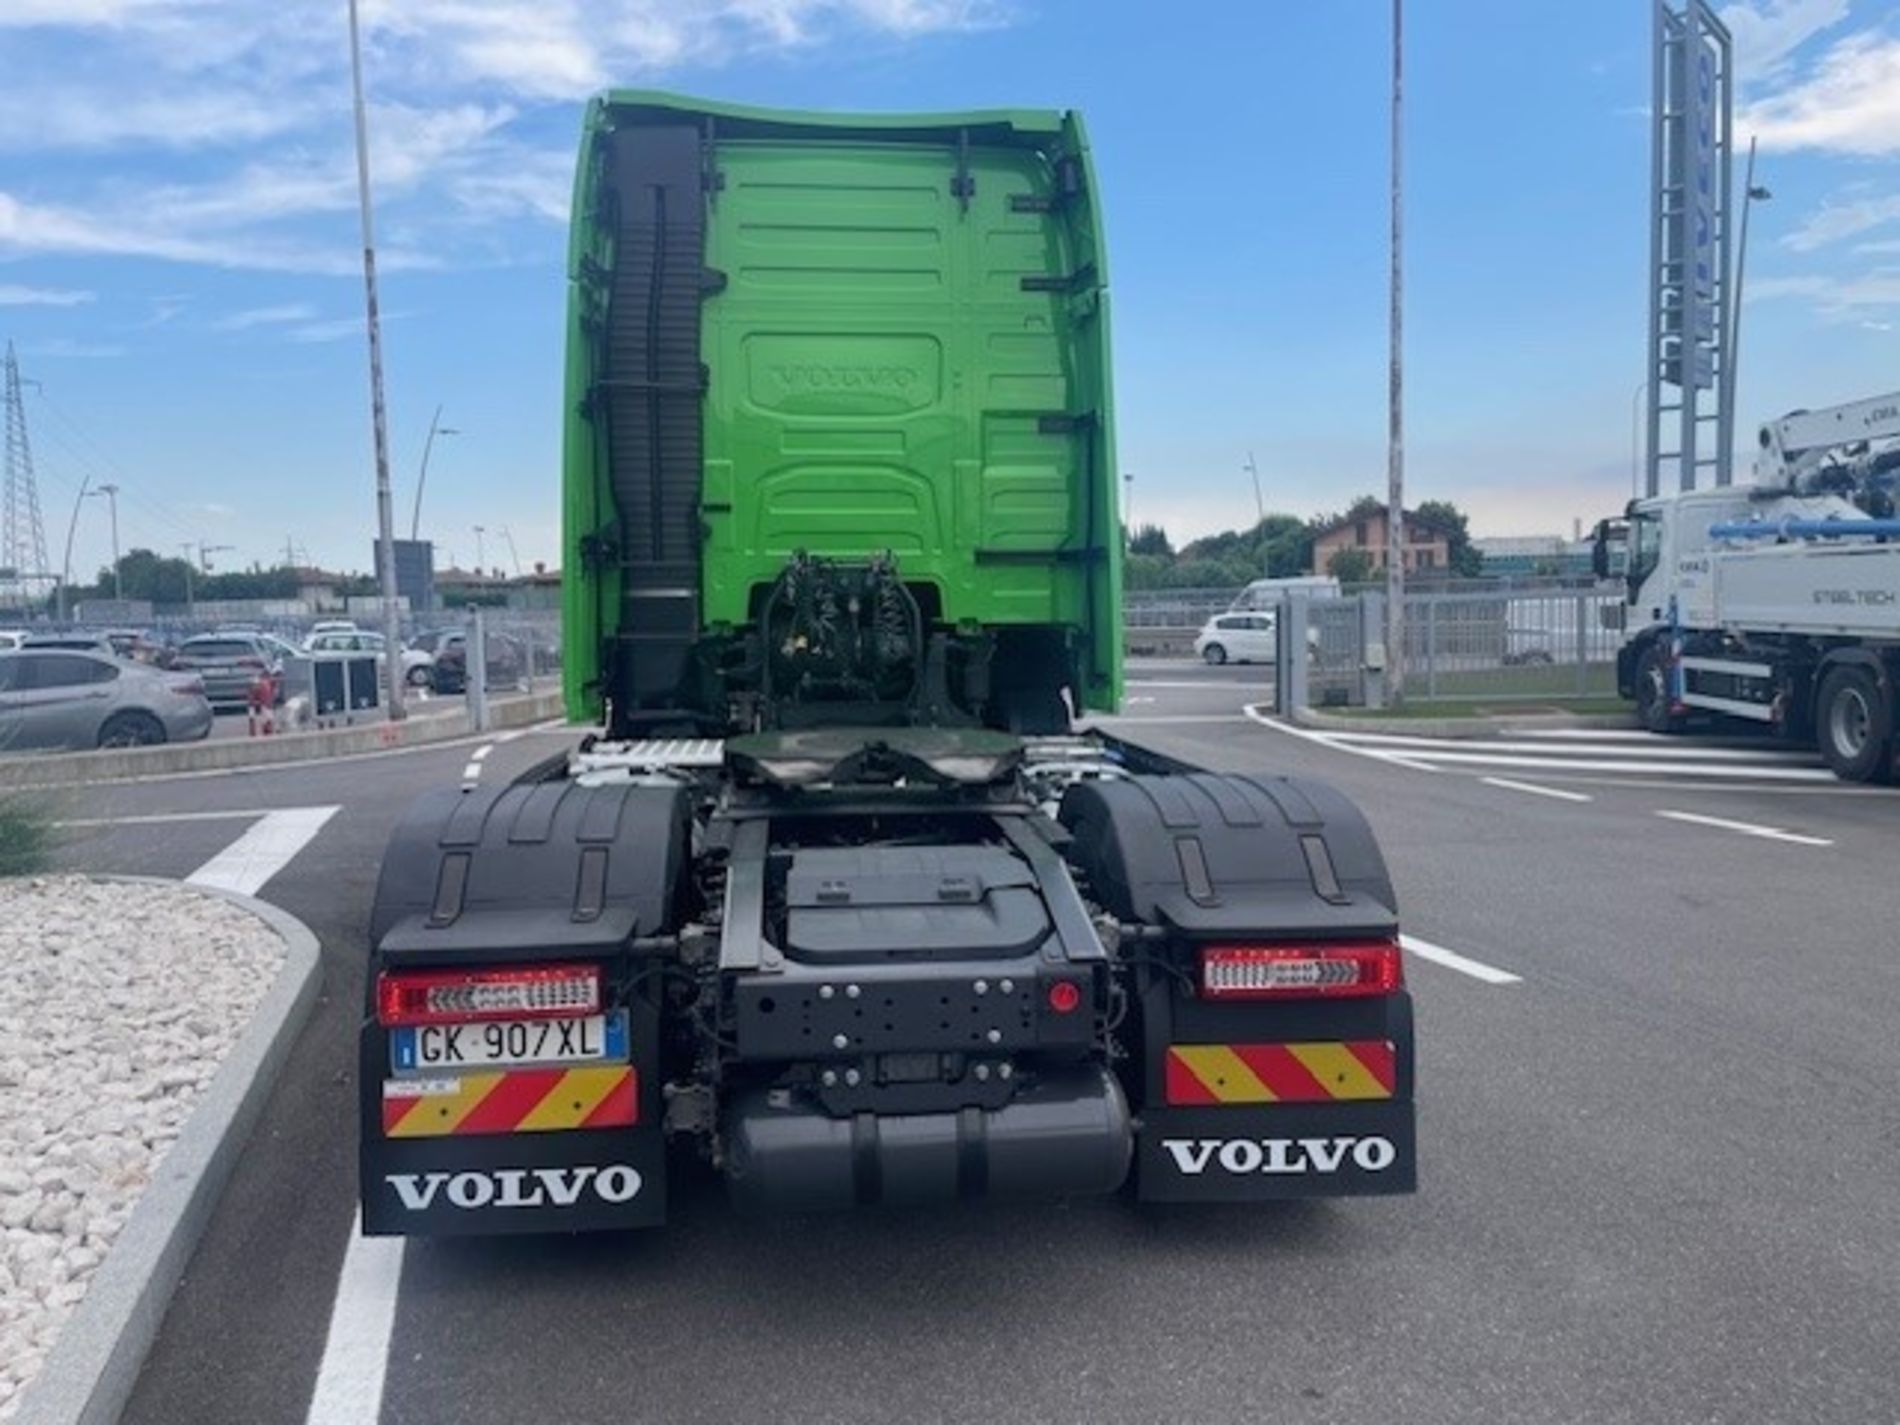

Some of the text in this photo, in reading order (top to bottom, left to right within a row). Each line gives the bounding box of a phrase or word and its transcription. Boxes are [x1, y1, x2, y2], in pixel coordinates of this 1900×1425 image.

[420, 1020, 599, 1061] GK 907XL
[1162, 1136, 1396, 1174] VOLVO
[385, 1165, 642, 1210] VOLVO
